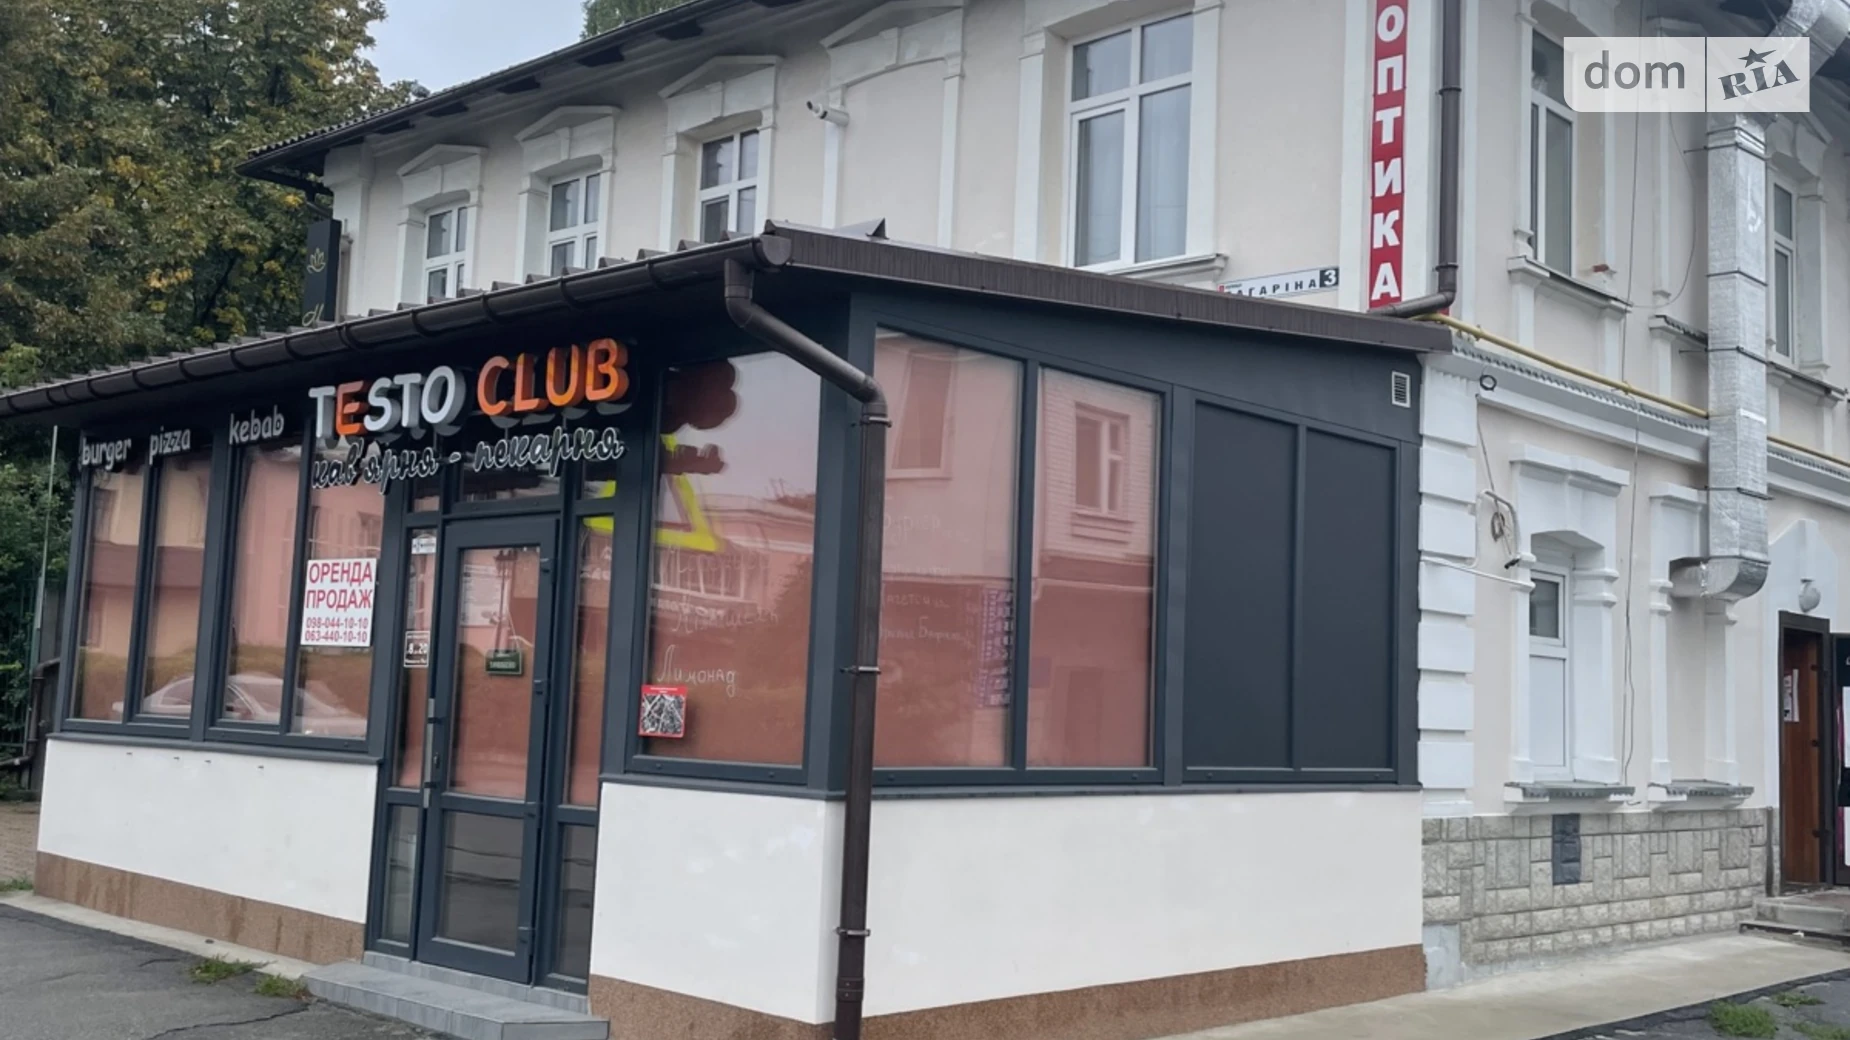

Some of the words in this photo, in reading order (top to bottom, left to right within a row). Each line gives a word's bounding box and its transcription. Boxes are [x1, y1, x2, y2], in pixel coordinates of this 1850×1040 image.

[1370, 5, 1405, 301] ОПТИКА
[1226, 278, 1317, 297] АГАРІНА
[1323, 269, 1337, 286] 3
[308, 365, 466, 439] TESTO
[477, 338, 629, 416] CLUB
[229, 405, 284, 445] kebab
[81, 437, 132, 471] burger
[149, 425, 191, 465] pizza
[473, 426, 624, 477] пекарня
[309, 562, 373, 587] ОРЕНДА
[306, 589, 373, 612] ПРОДАЖ
[304, 631, 368, 643] 063-440-10-10
[306, 617, 369, 629] 098-044-10-10
[657, 644, 736, 698] Лимонад
